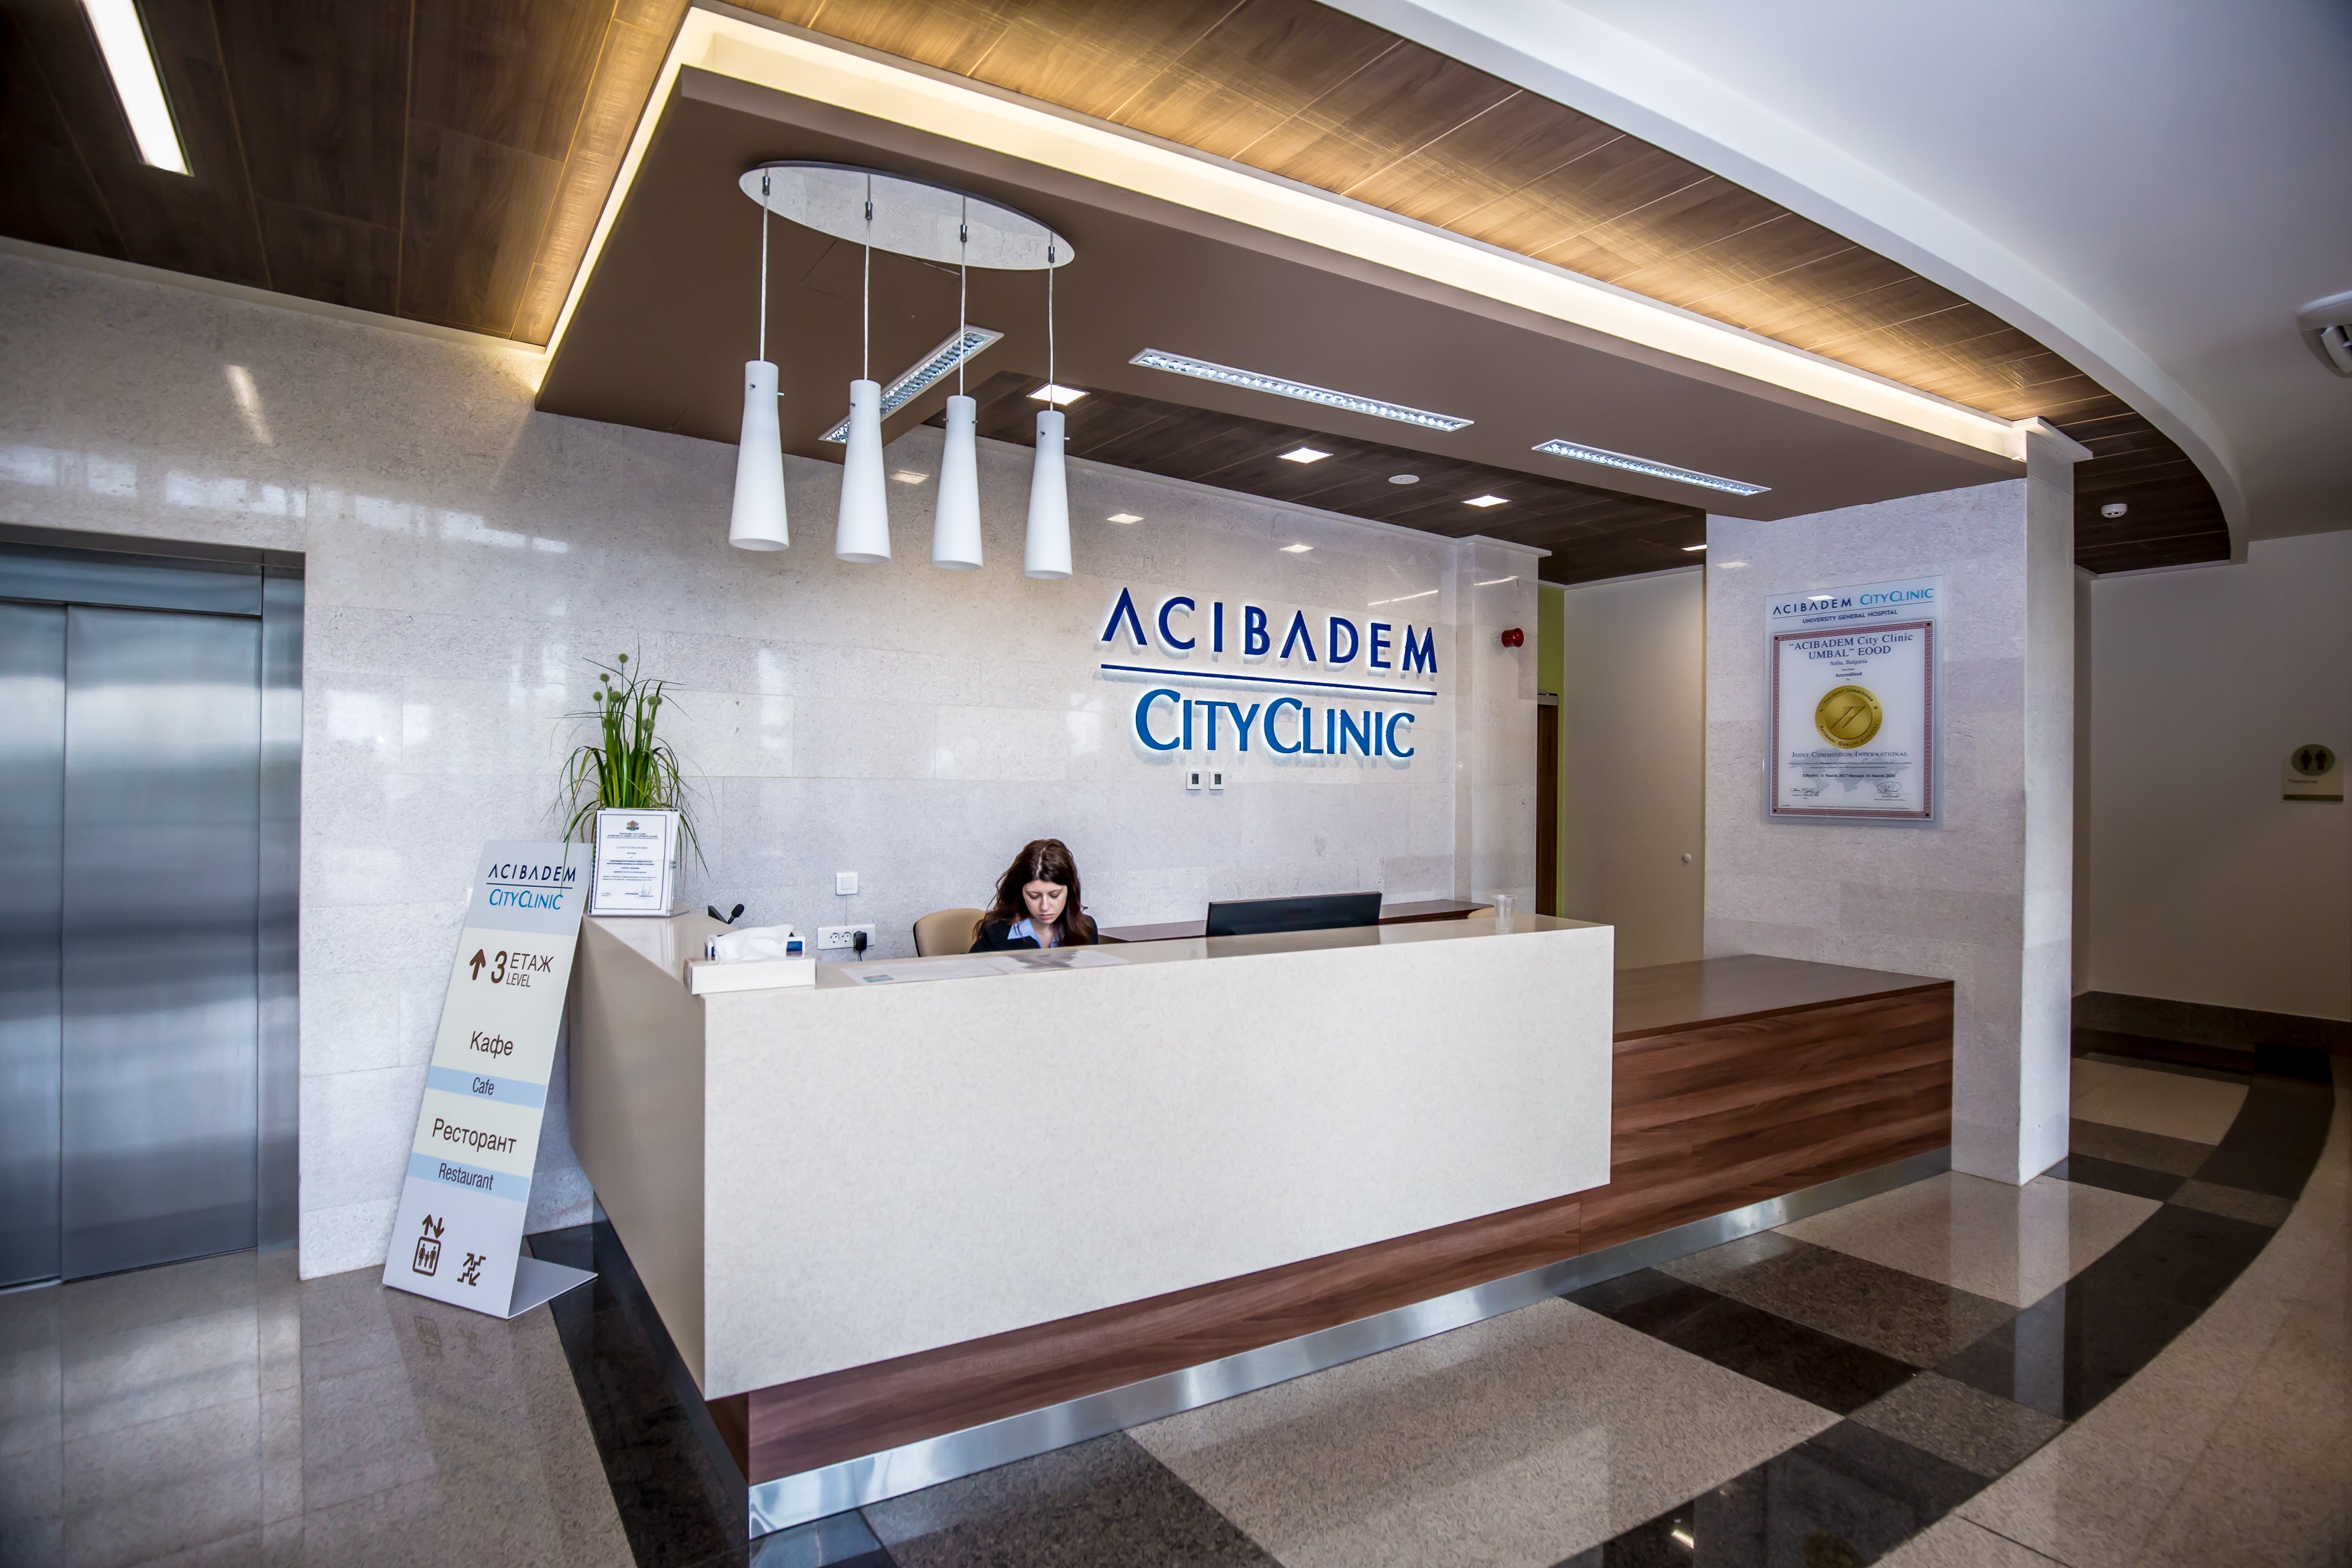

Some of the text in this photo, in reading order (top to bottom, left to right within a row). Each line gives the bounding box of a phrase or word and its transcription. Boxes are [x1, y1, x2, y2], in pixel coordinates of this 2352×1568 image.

[1773, 598, 1852, 615] ACIBADEM
[1803, 610, 1898, 624] UNIVERSITY GENERAL HOSPITAL
[1101, 587, 1438, 674] ACIBADEM
[1857, 636, 1878, 646] City
[1882, 633, 1914, 644] Clinic
[1858, 645, 1892, 657] EOOD
[488, 863, 576, 882] ACIBADEM
[490, 951, 554, 983] 3 ЕТАЖ
[506, 973, 531, 987] LEVEL
[470, 1030, 514, 1059] Кафе
[472, 1076, 495, 1096] Cafe
[432, 1118, 517, 1154] Ресторант
[438, 1163, 494, 1190] Restaurant
